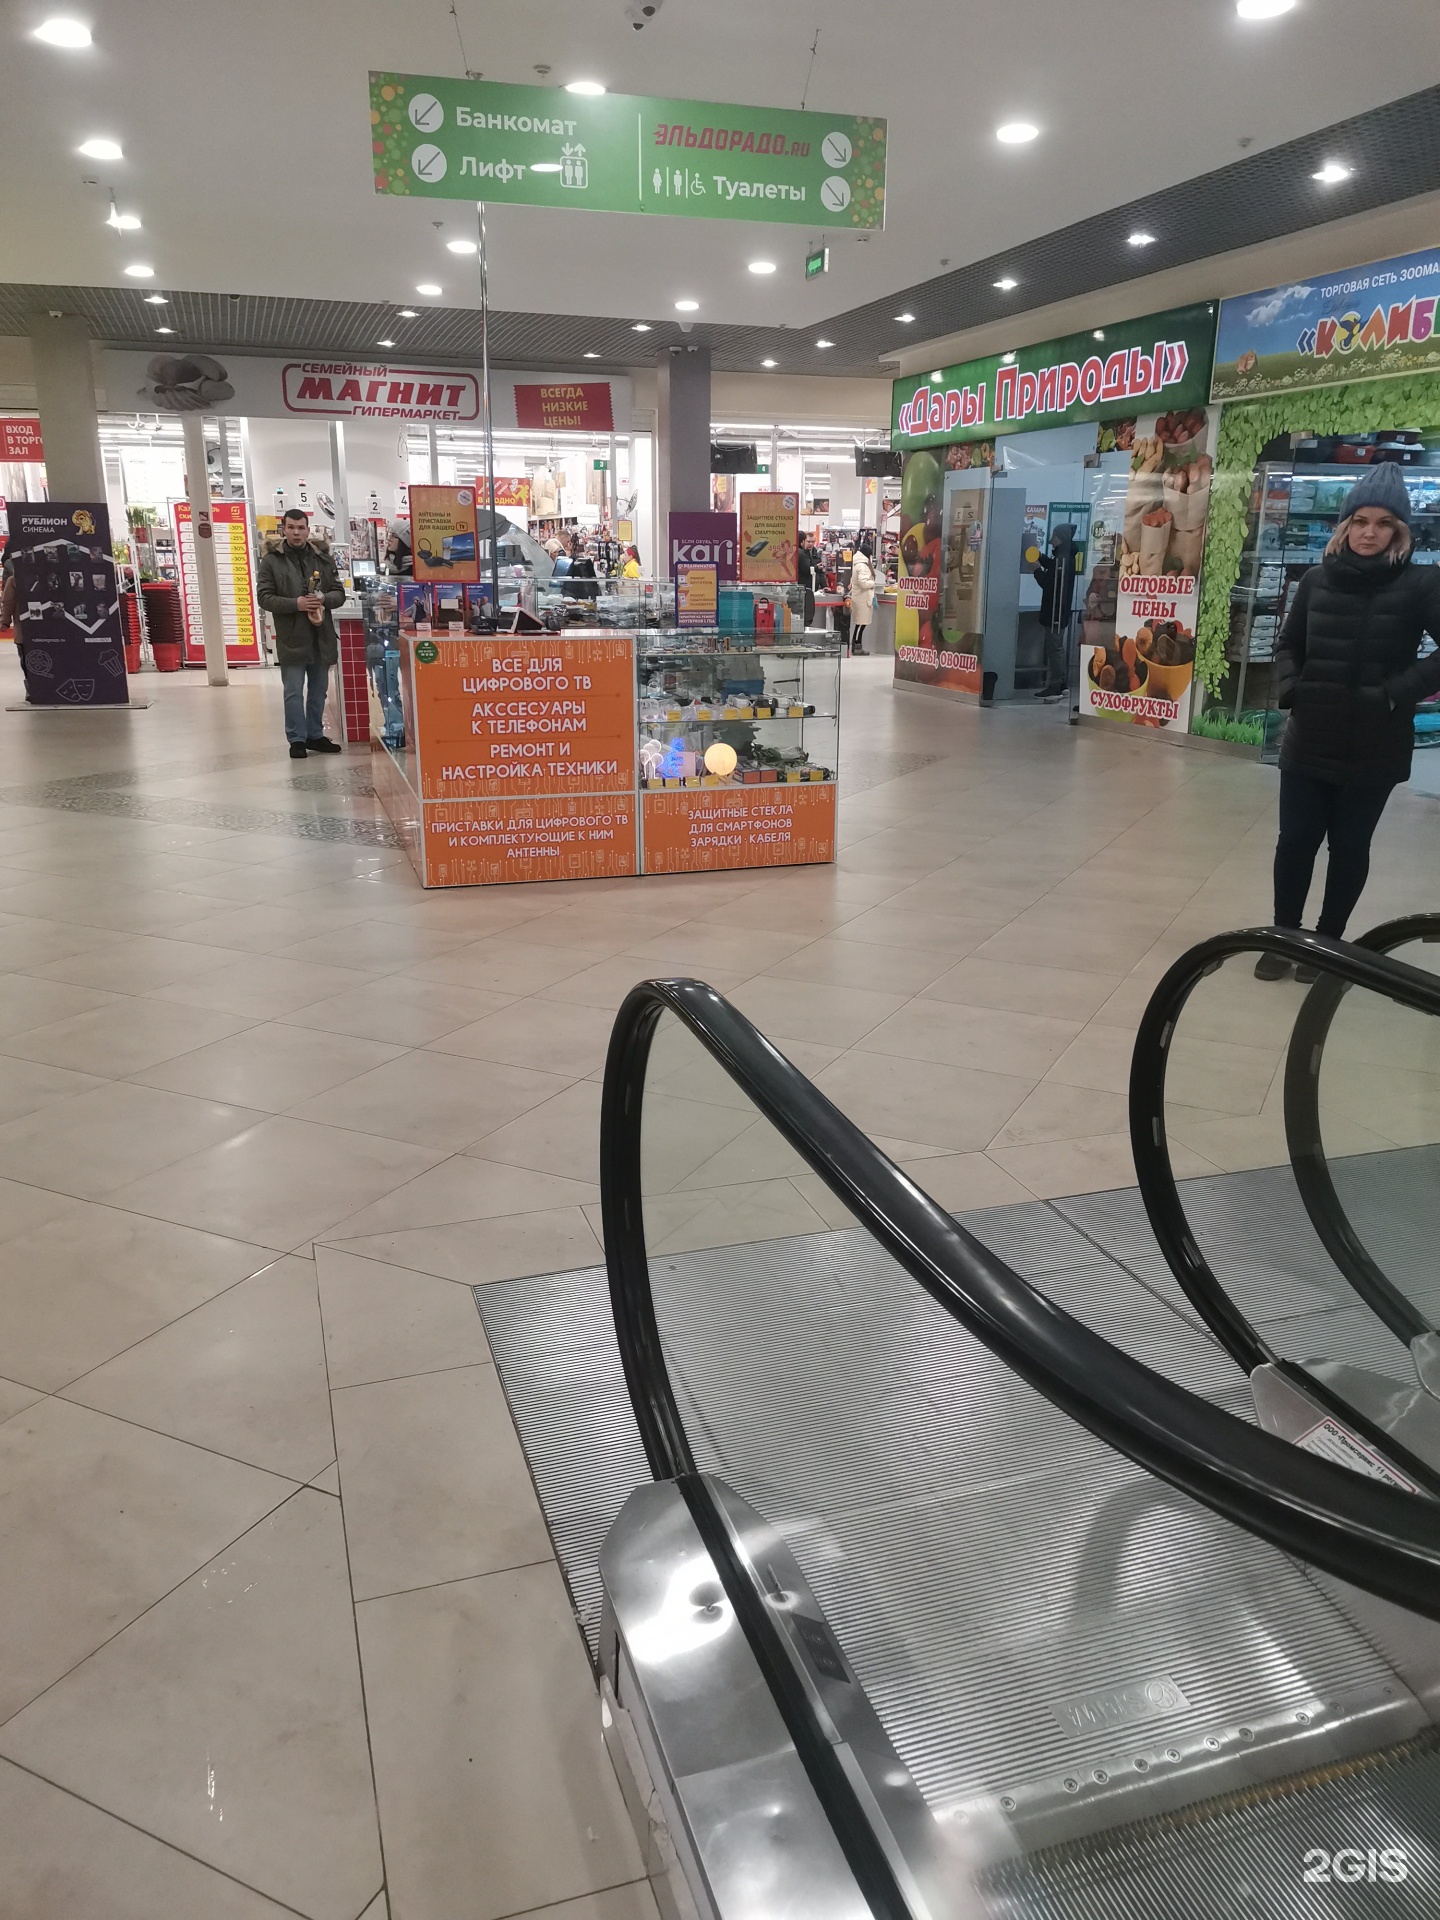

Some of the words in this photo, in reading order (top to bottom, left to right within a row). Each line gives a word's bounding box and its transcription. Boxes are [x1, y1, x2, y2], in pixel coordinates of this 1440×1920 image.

[456, 106, 577, 136] Банкомат
[459, 156, 526, 184] Лифт
[713, 175, 806, 201] Туалеты
[1320, 278, 1370, 299] ТОРГОВАЯ
[1371, 271, 1398, 288] СЕТЬ
[1400, 261, 1440, 282] ЗООМА
[1297, 294, 1440, 360] «КОЛИБ
[302, 362, 388, 378] СЕМЕЙНЫЙ
[296, 377, 467, 407] МАГНИТ
[540, 387, 585, 400] ВСЕГДА
[898, 382, 987, 437] «Дары
[994, 340, 1189, 422] Природы»
[352, 406, 461, 421] ГИПЕРМАРКЕТ
[542, 401, 589, 413] НИЗКИЕ
[543, 415, 581, 428] ЦЕНЫ!
[5, 425, 34, 436] ВХОД
[7, 436, 14, 445] В
[9, 446, 29, 455] ЗАЛ
[278, 500, 284, 509] 1
[301, 492, 308, 503] 5
[401, 495, 407, 505] 4
[372, 502, 378, 511] 2
[21, 517, 68, 527] РУБЛИОН
[22, 525, 56, 534] СИНЕМА
[672, 539, 733, 565] kari
[899, 577, 938, 593] ОПТОВЫЕ
[1120, 576, 1195, 595] ОПТОВЫЕ
[905, 594, 929, 610] ЦЕНЫ
[1131, 599, 1178, 619] ЦЕНЫ
[492, 658, 523, 673] ВСЕ
[527, 657, 563, 674] ДЛЯ
[899, 645, 940, 670] ФРУКТЫ,
[940, 650, 978, 673] ОВОЩИ
[462, 676, 569, 694] ЦИФРОВОГО
[573, 675, 592, 690] ТВ
[472, 700, 586, 718] АКССЕСУАРЫ
[1089, 689, 1180, 720] СУХОФРУКТЫ
[471, 719, 483, 735] К
[487, 717, 587, 734] ТЕЛЕФОНАМ
[490, 743, 554, 759] РЕМОНТ
[559, 742, 571, 756] И
[442, 761, 544, 781] НАСТРОЙКА
[547, 760, 618, 777] ТЕХНИКИ
[688, 806, 749, 821] ЗАЩИТНЫЕ
[751, 804, 794, 817] СТЕКЛА
[431, 820, 504, 834] ПРИСТАВКИ
[506, 818, 533, 832] ДЛЯ
[535, 814, 612, 830] ЦИФРОВОГО
[615, 814, 629, 826] ТВ
[688, 823, 714, 836] ДЛЯ
[715, 818, 793, 833] СМАРТФОНОВ
[448, 836, 458, 847] И
[460, 832, 576, 847] КОМПЛЕКТУЮЩИЕ
[578, 831, 586, 841] К
[588, 829, 614, 841] НИМ
[690, 834, 742, 848] ЗАРЯДКИ
[749, 831, 791, 844] КАБЕЛЯ
[507, 845, 560, 858] АНТЕННЫ
[1324, 1423, 1339, 1436] ООО
[1375, 1466, 1385, 1475] 11
